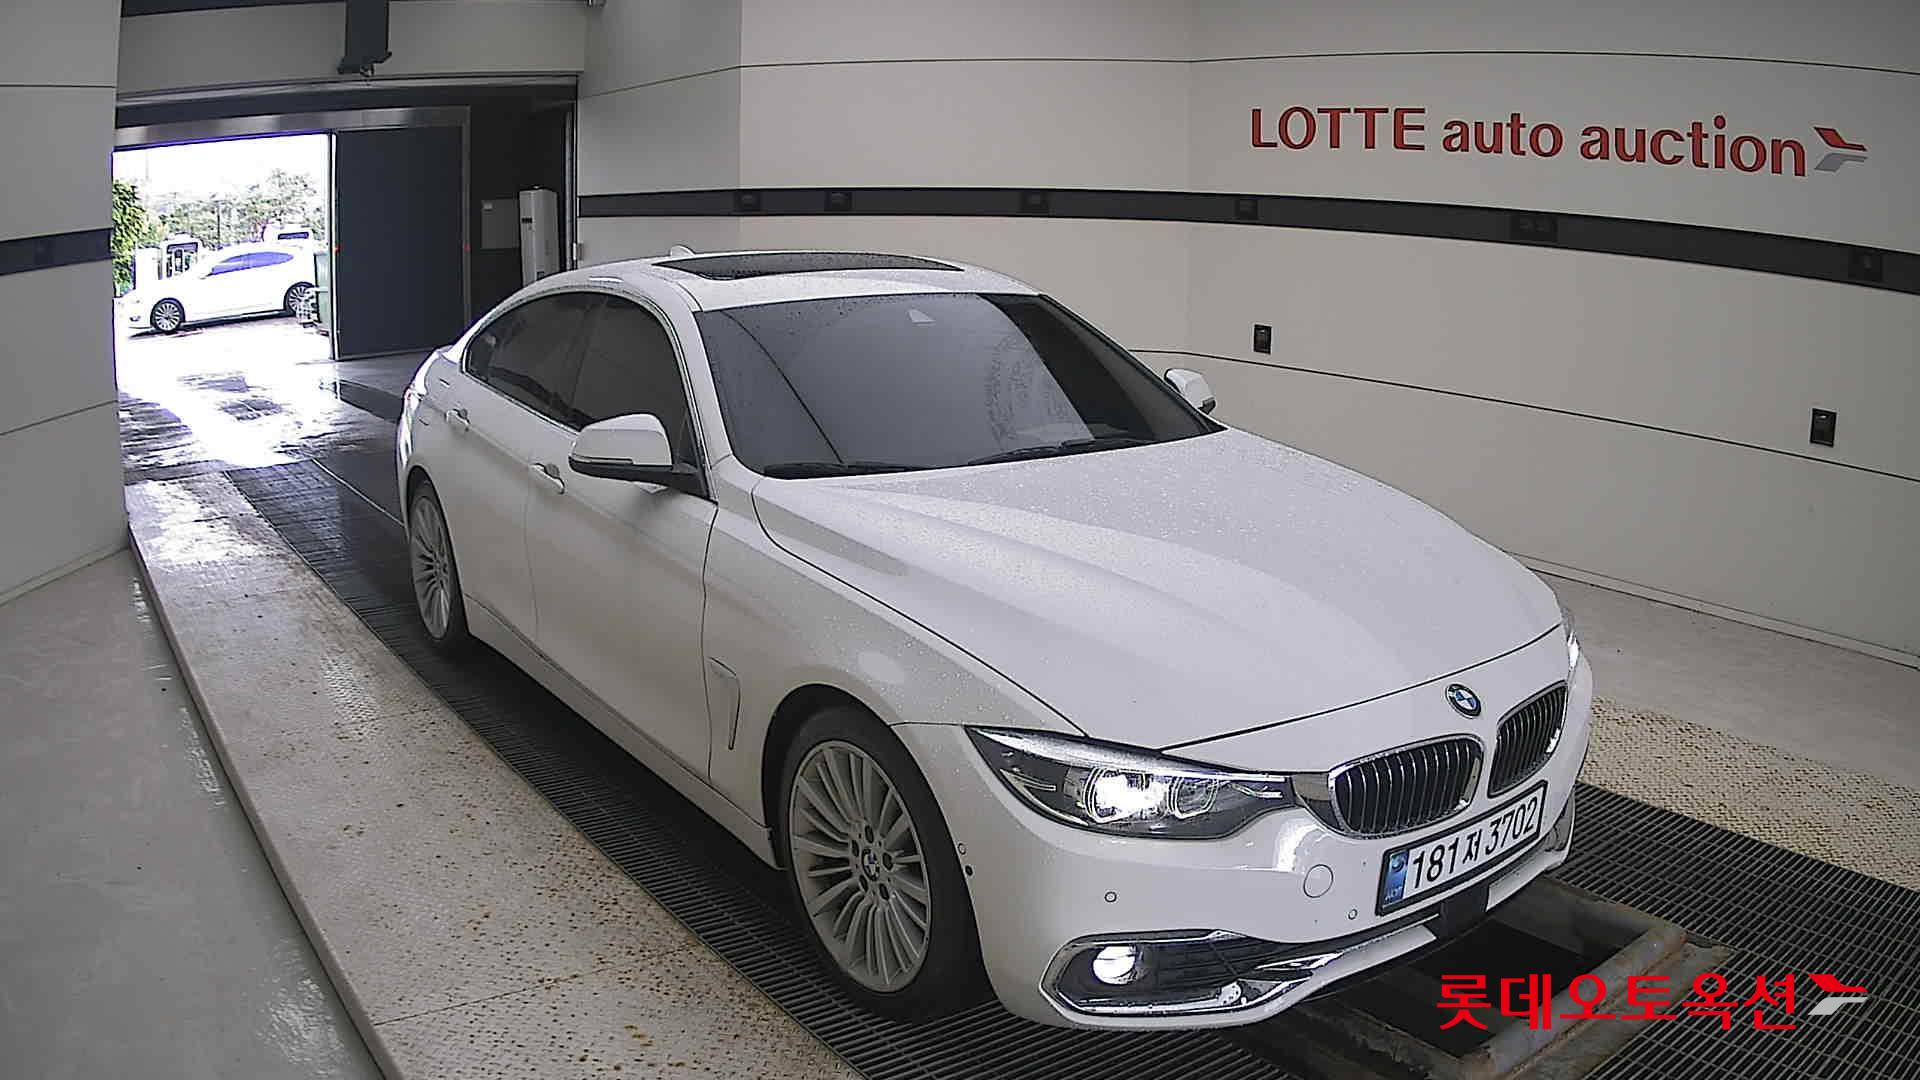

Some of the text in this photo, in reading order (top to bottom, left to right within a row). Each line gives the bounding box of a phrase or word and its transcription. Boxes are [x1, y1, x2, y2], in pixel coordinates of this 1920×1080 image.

[1251, 107, 1807, 177] LOTTE auto auction
